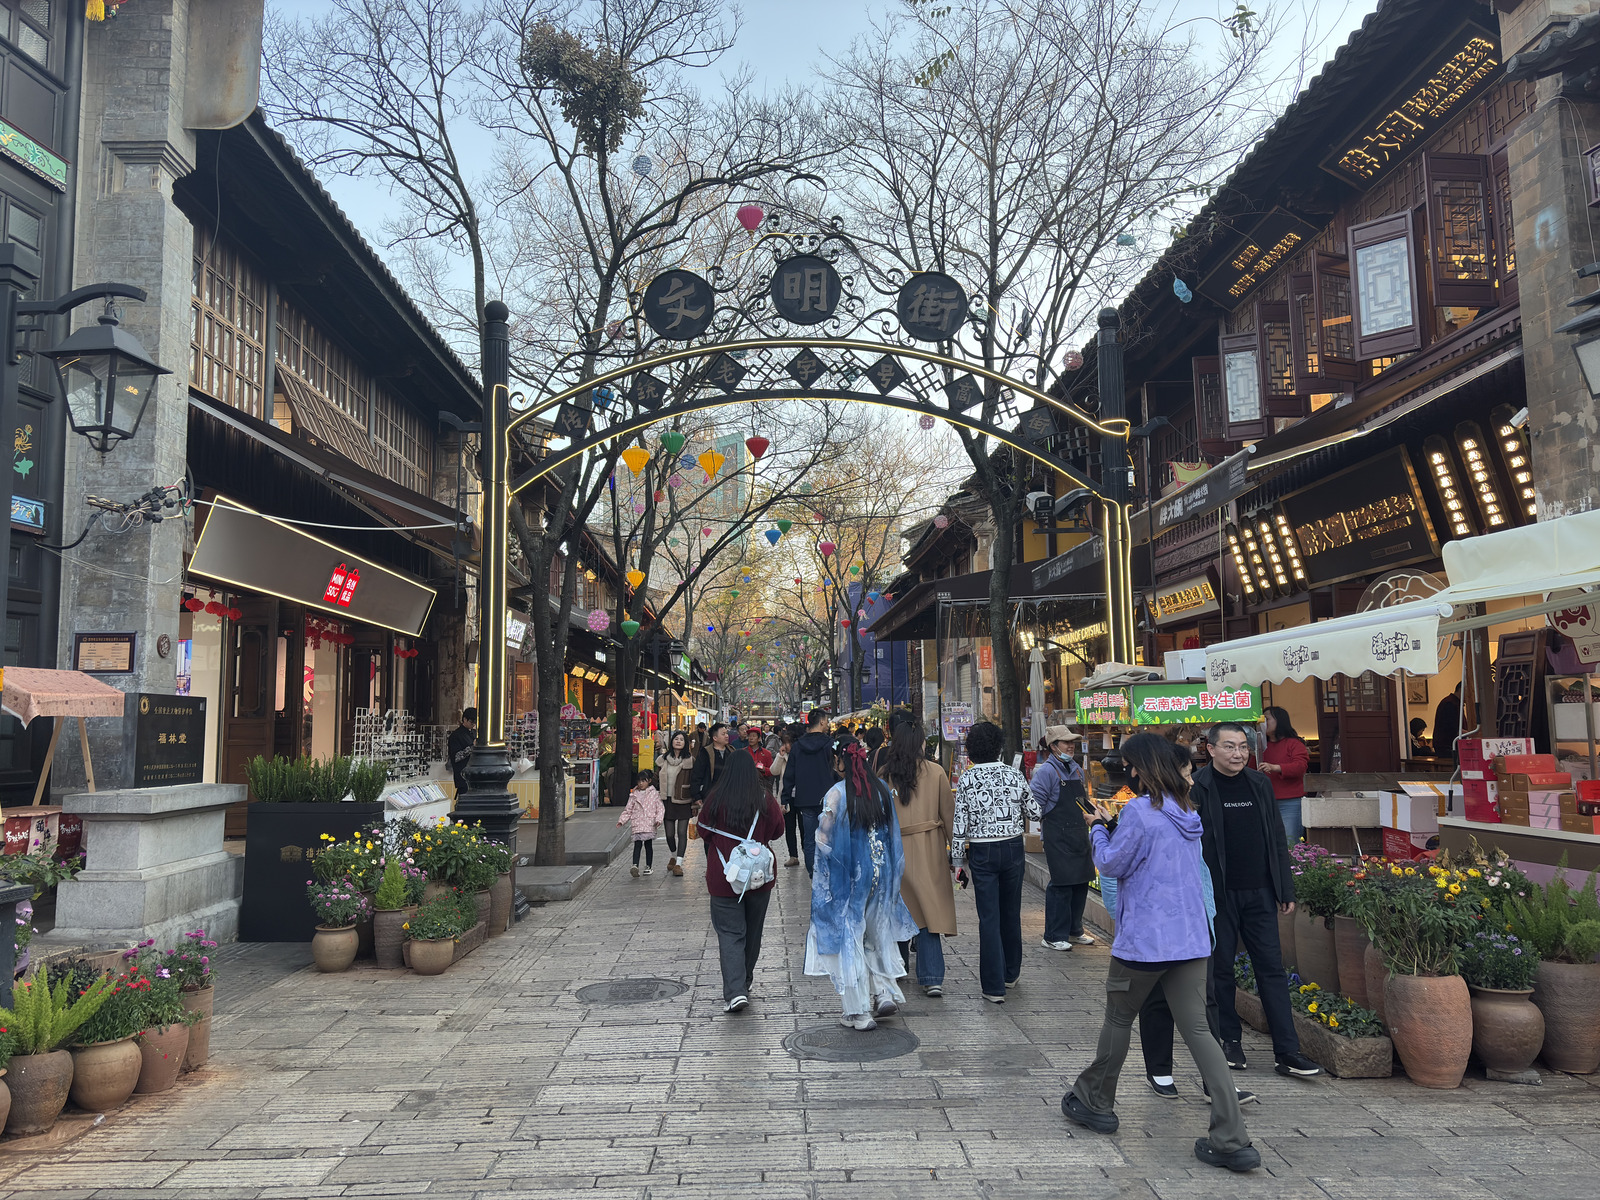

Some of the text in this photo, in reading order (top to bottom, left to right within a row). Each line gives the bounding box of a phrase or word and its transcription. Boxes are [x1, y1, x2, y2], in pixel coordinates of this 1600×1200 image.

[1429, 58, 1498, 117] PANGDAWAN
[658, 267, 960, 336] 文明街
[561, 354, 1052, 436] 传统老字号商街
[331, 573, 345, 586] MINI
[345, 578, 357, 591] 名创
[341, 590, 352, 603] 优品
[1081, 622, 1103, 640] CRYSTAL
[1144, 690, 1252, 712] 云南特产 野生菌
[158, 732, 187, 745] 福林堂
